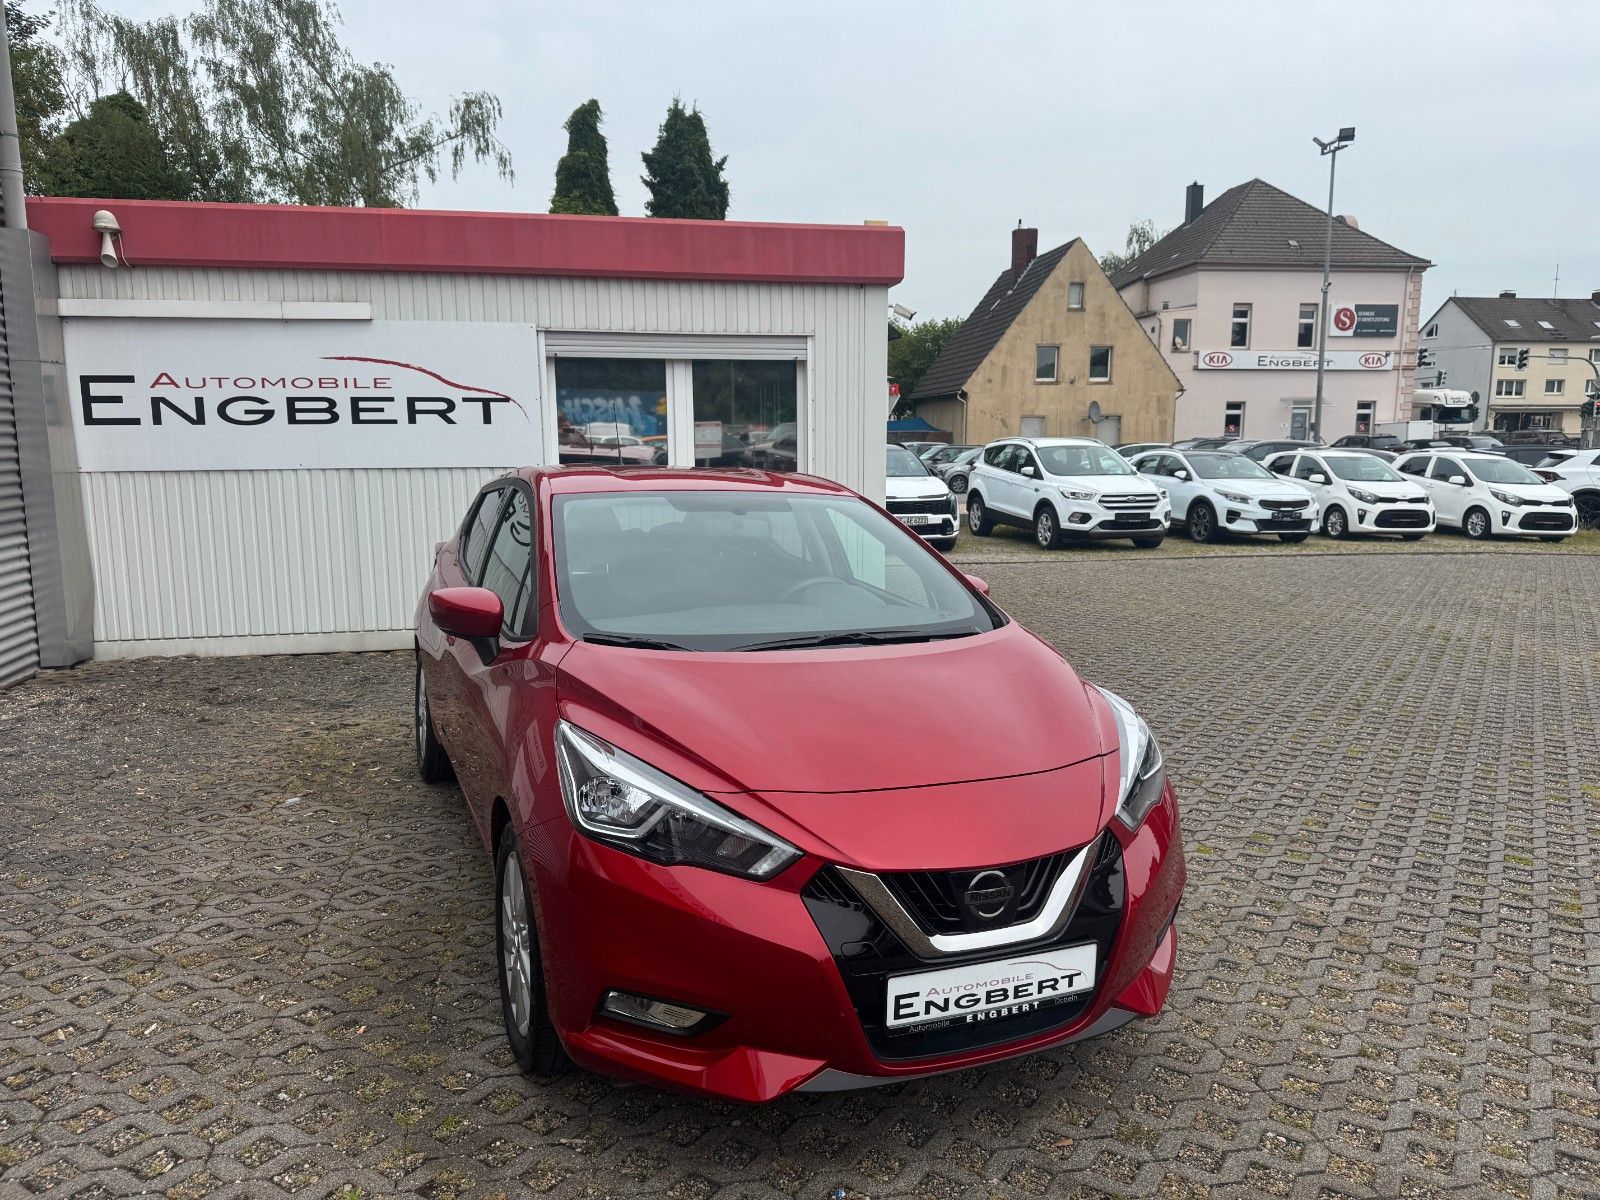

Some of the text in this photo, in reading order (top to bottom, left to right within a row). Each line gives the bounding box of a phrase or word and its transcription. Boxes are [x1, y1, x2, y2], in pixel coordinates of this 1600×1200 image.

[1338, 310, 1350, 329] S
[1209, 355, 1228, 364] KIA
[1364, 356, 1382, 365] KIA
[149, 372, 393, 390] AUTOMOBILE
[79, 374, 511, 426] ENGBERT
[970, 887, 1010, 902] NISSAN
[925, 972, 1034, 997] AUTOMOBILE
[893, 972, 1082, 1021] ENGBERT
[908, 1020, 950, 1033] Automobile
[966, 1001, 1040, 1023] ENGBERT
